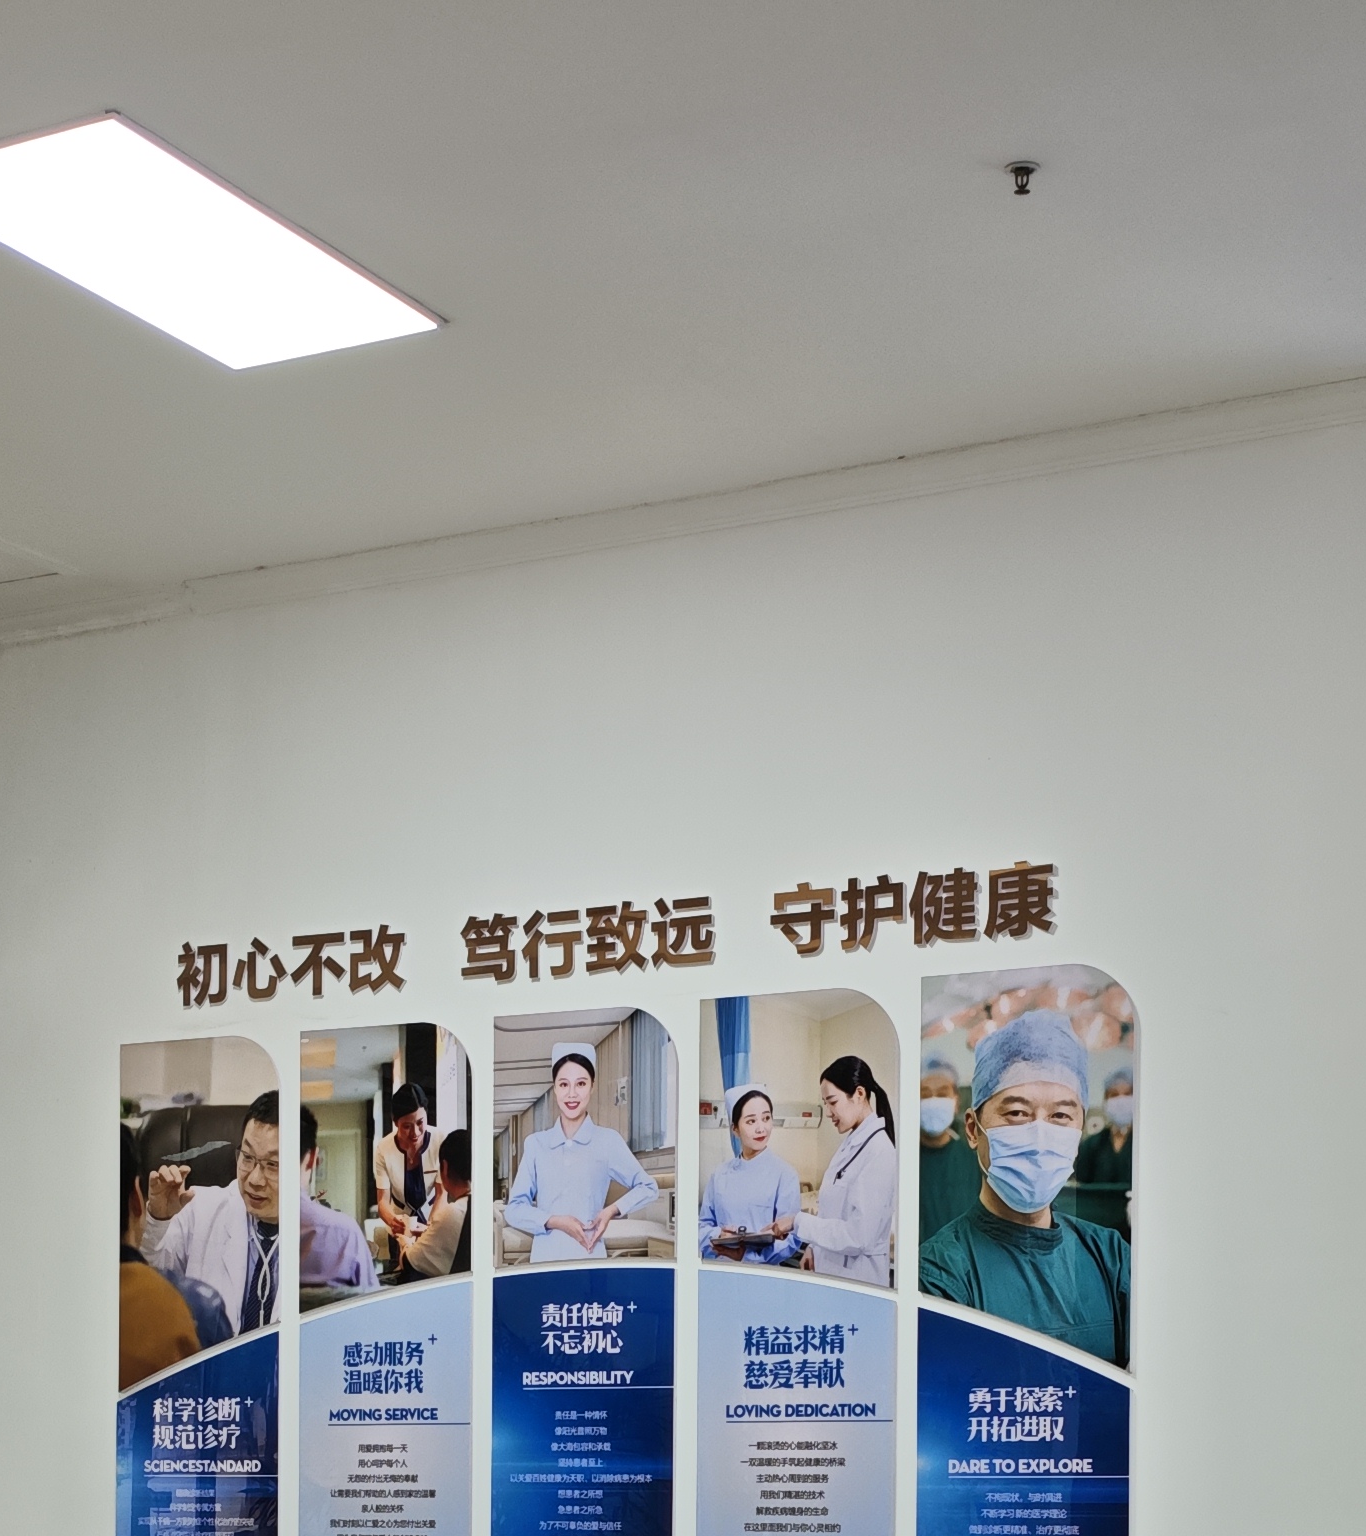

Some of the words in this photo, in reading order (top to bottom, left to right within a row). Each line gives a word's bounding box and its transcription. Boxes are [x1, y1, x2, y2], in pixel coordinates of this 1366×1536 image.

[176, 925, 407, 1007] 初心不改
[458, 897, 718, 983] 笃行致远
[769, 861, 1060, 957] 守护健康
[541, 1302, 623, 1328] 责任使命
[541, 1329, 623, 1355] 不忘初心
[743, 1324, 844, 1356] 精益求精
[343, 1341, 424, 1367] 感动服务
[343, 1368, 424, 1394] 温暖你我
[522, 1370, 634, 1386] RESPONSIBILITY
[743, 1358, 845, 1389] 慈爱奉献
[152, 1396, 241, 1423] 科学诊断
[726, 1404, 781, 1418] LOVING
[785, 1403, 876, 1417] DEDICATION
[968, 1386, 1063, 1414] 勇于探索
[329, 1408, 382, 1421] MOVING
[385, 1407, 438, 1421] SERVICE
[152, 1424, 241, 1450] 规范诊疗
[967, 1416, 1064, 1442] 开拓进取
[143, 1459, 262, 1473] SCIENCESTANDARD
[756, 1474, 829, 1483] 主动热心周到的服务
[948, 1459, 990, 1474] DARE
[992, 1459, 1016, 1473] TO
[1019, 1458, 1093, 1473] EXPLORE
